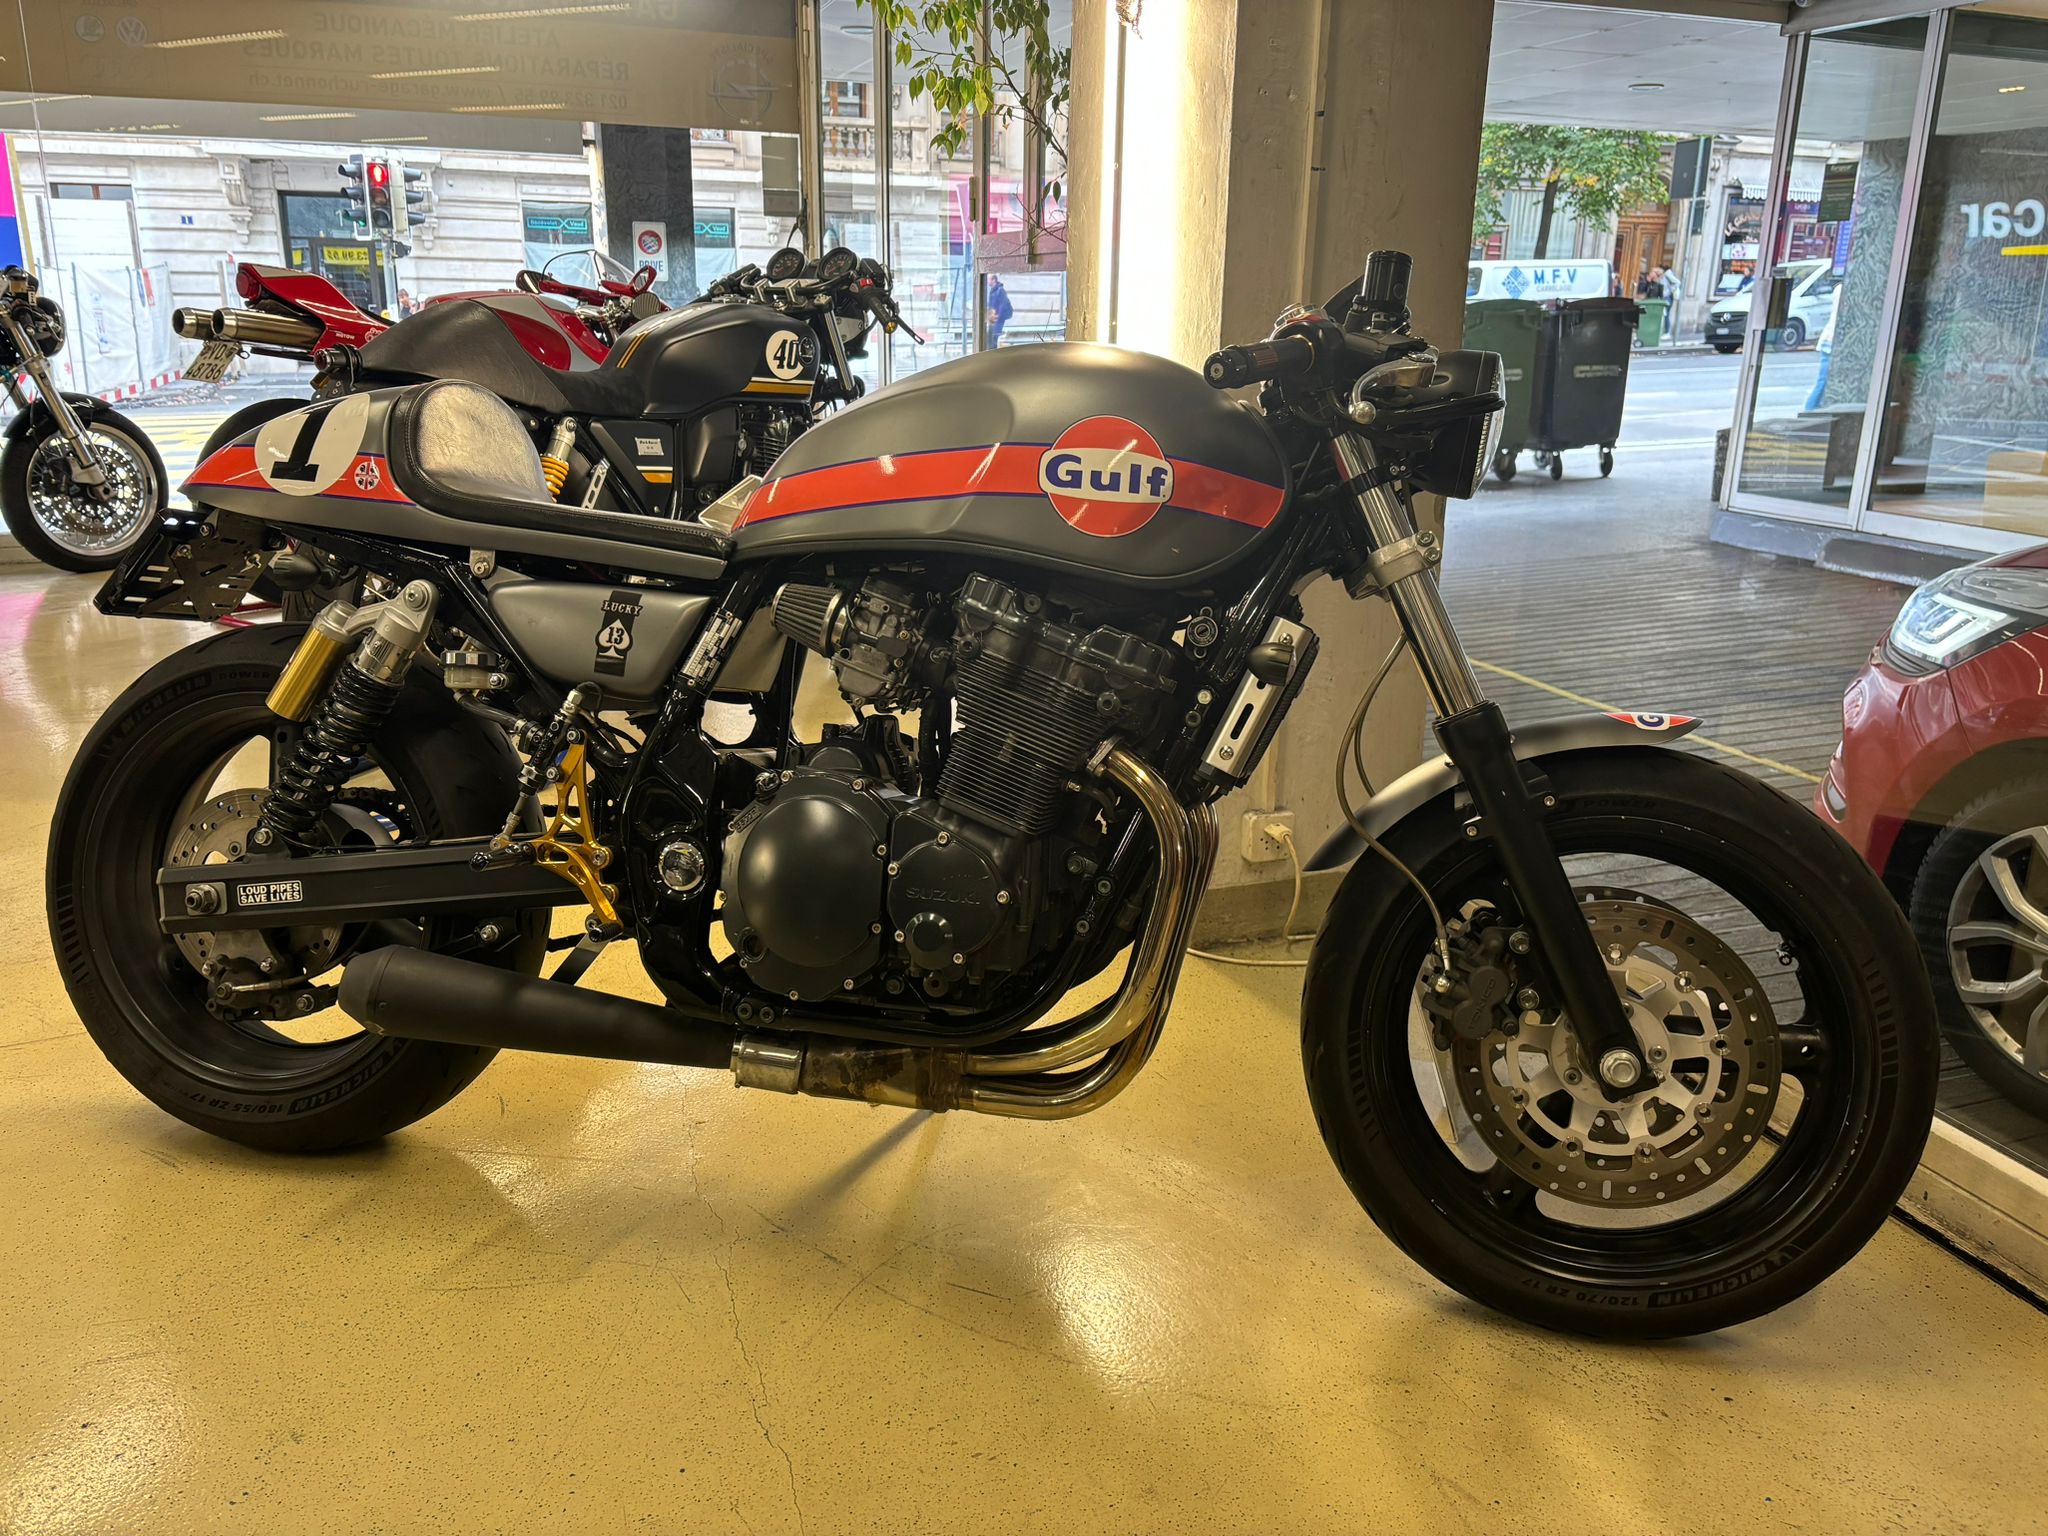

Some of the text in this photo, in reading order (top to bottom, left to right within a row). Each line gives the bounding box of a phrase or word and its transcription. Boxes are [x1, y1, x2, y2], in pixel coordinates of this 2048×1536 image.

[773, 339, 799, 369] 40
[270, 399, 348, 482] 1
[1045, 453, 1168, 497] Gulf
[602, 600, 642, 616] LUCKY
[605, 626, 625, 645] 13
[120, 671, 211, 736] MICHELIN
[239, 882, 300, 895] LOUD PIPES
[240, 891, 300, 904] SAVE LIVES
[294, 1055, 384, 1113] MICHELIN
[1575, 1291, 1639, 1306] 120/70
[1656, 1262, 1769, 1306] MICHELIN
